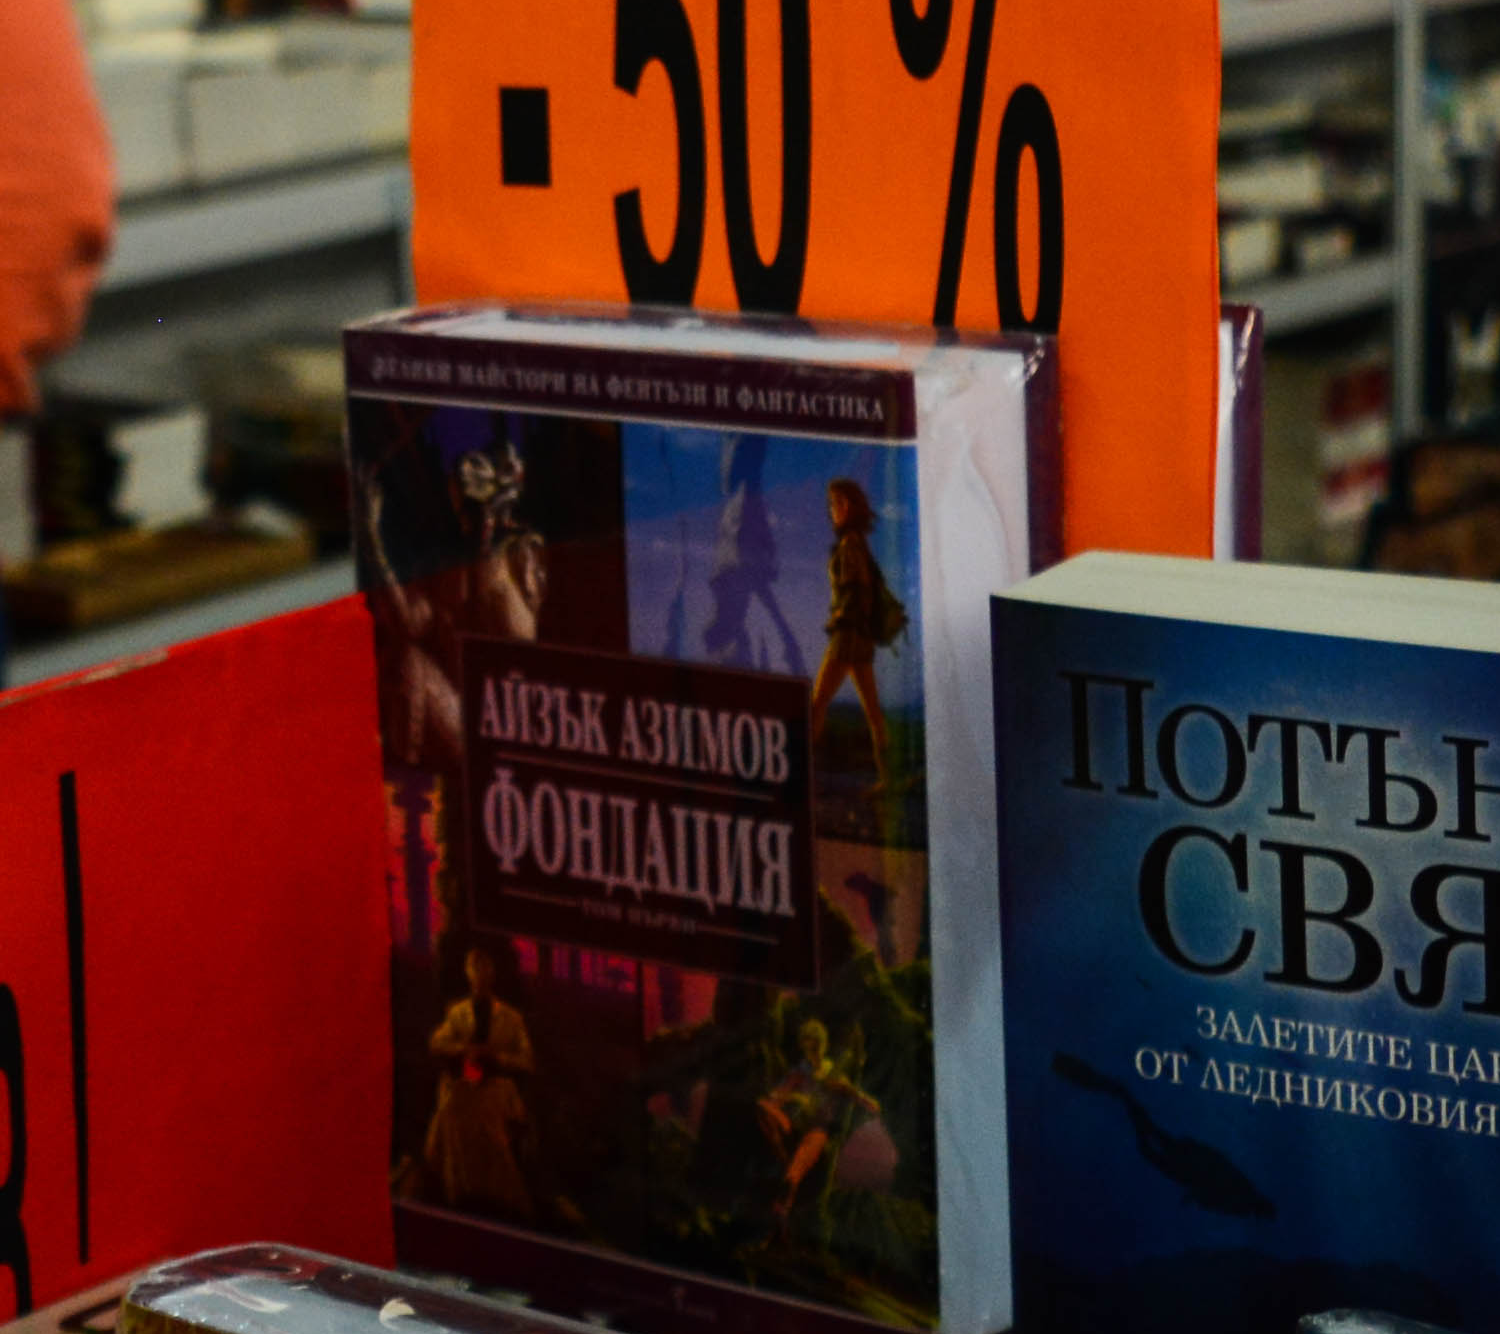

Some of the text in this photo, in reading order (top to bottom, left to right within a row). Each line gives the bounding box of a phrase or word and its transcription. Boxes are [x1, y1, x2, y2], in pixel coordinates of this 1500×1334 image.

[458, 360, 567, 393] МАЙСТОРИ
[573, 374, 600, 397] НА
[606, 375, 708, 408] ФЕНТЪЗИ
[714, 385, 732, 408] И
[736, 386, 885, 422] ФАНТАСТИКА
[479, 670, 790, 784] АЙЗЪК АЗИМОВ
[483, 768, 796, 920] ФОНДАЦИЯ
[1196, 1004, 1413, 1072] ЗАЛЕТИТЕ
[1133, 1045, 1190, 1083] ОТ
[1199, 1059, 1500, 1138] ЛЕДНИКОВИЯ
